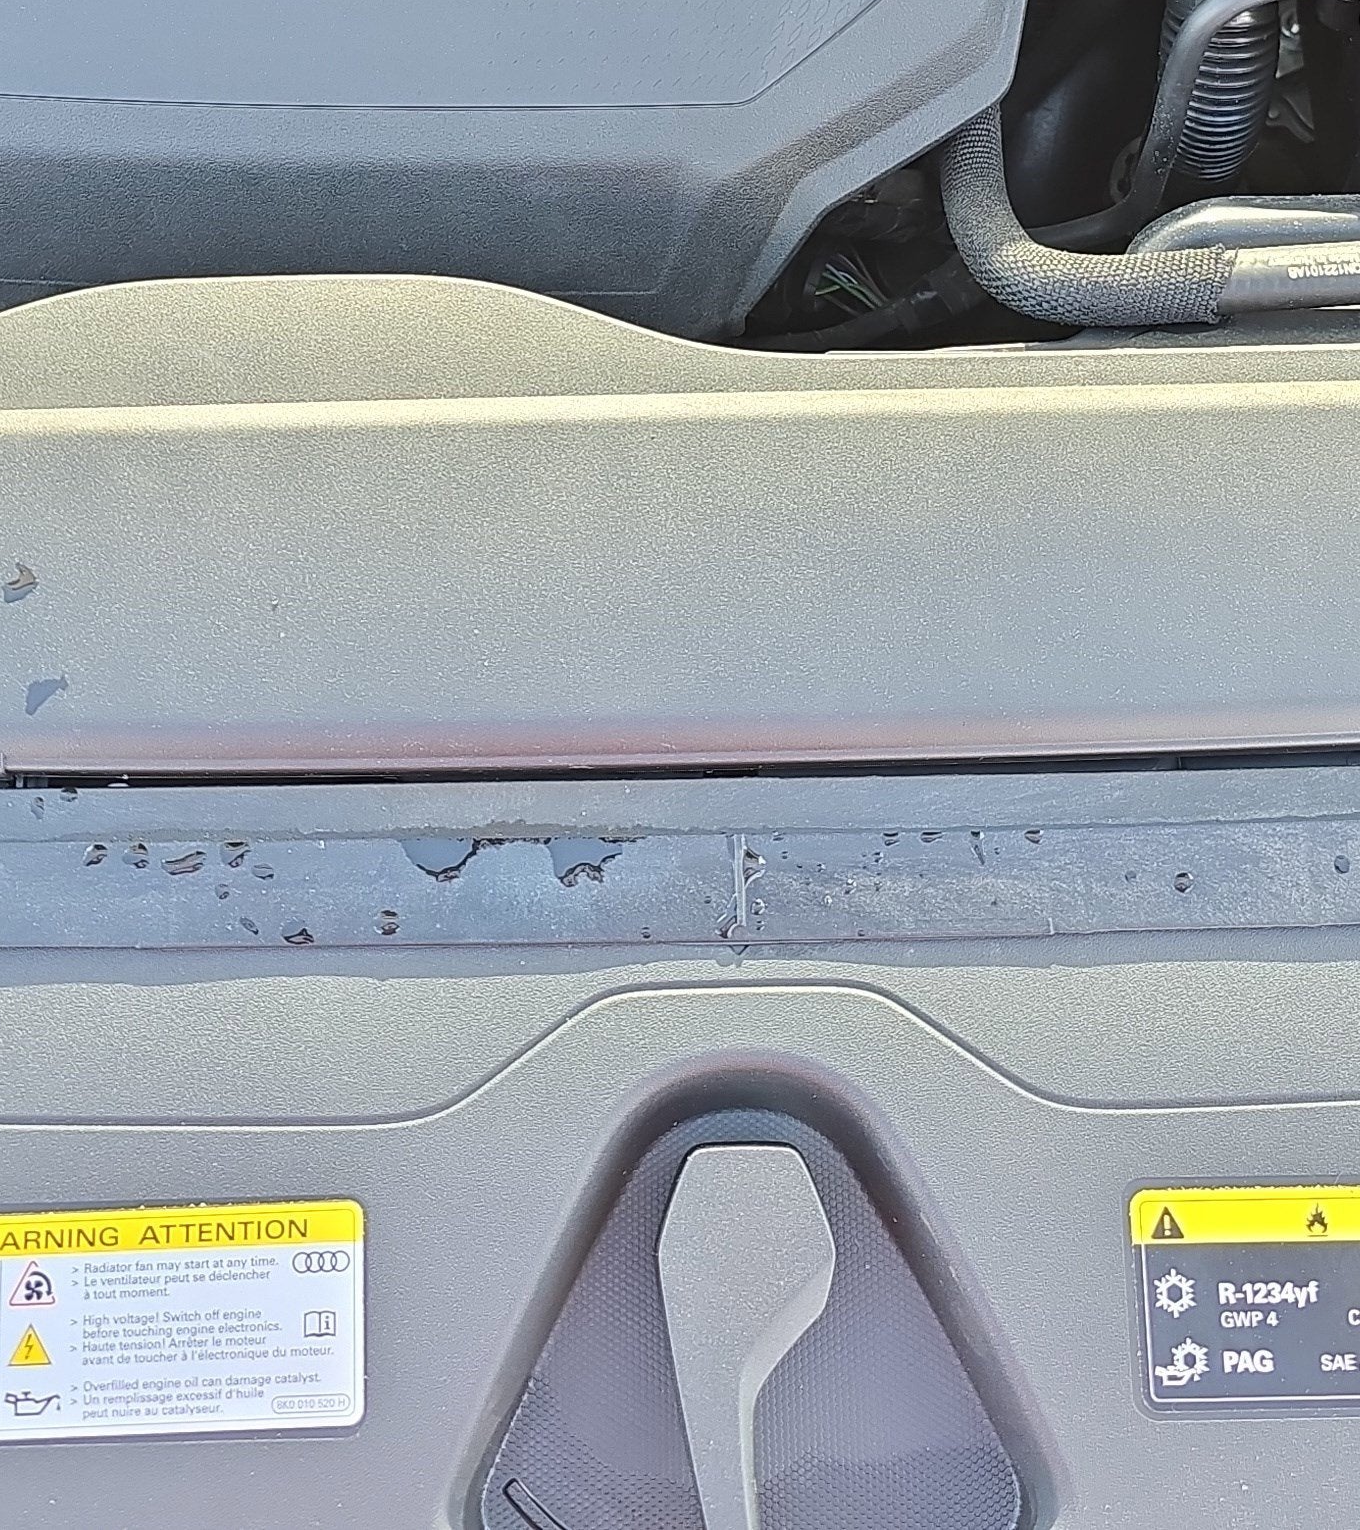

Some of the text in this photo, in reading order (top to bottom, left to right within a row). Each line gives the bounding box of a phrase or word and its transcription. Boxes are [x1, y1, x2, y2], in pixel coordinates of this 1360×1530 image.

[138, 1219, 309, 1245] ATTENTION
[84, 1257, 279, 1273] Radiator fan may start at any time.
[84, 1276, 97, 1287] Le
[101, 1274, 160, 1286] ventilateur
[164, 1273, 190, 1286] peut
[209, 1270, 270, 1282] déclencher
[84, 1287, 170, 1299] à tout moment.
[1218, 1281, 1319, 1308] R-1234yf
[83, 1310, 262, 1327] High voltage! Switch off engine
[1220, 1312, 1263, 1328] GWP
[1266, 1312, 1279, 1327] 4
[83, 1322, 281, 1338] before touching engine electronics.
[83, 1337, 266, 1352] Haute tension! Arrêter le moteur
[82, 1347, 334, 1365] avant de toucher à l'électronique du moteur.
[1223, 1350, 1275, 1373] PAG
[1320, 1354, 1357, 1371] SAE
[84, 1373, 321, 1392] Overfilled engine oil can damage catalyst.
[84, 1389, 264, 1406] Un remplissage excessif d'huile
[298, 1399, 314, 1409] 010
[318, 1398, 335, 1408] 520
[83, 1404, 223, 1420] peut nuire au catalyseur.
